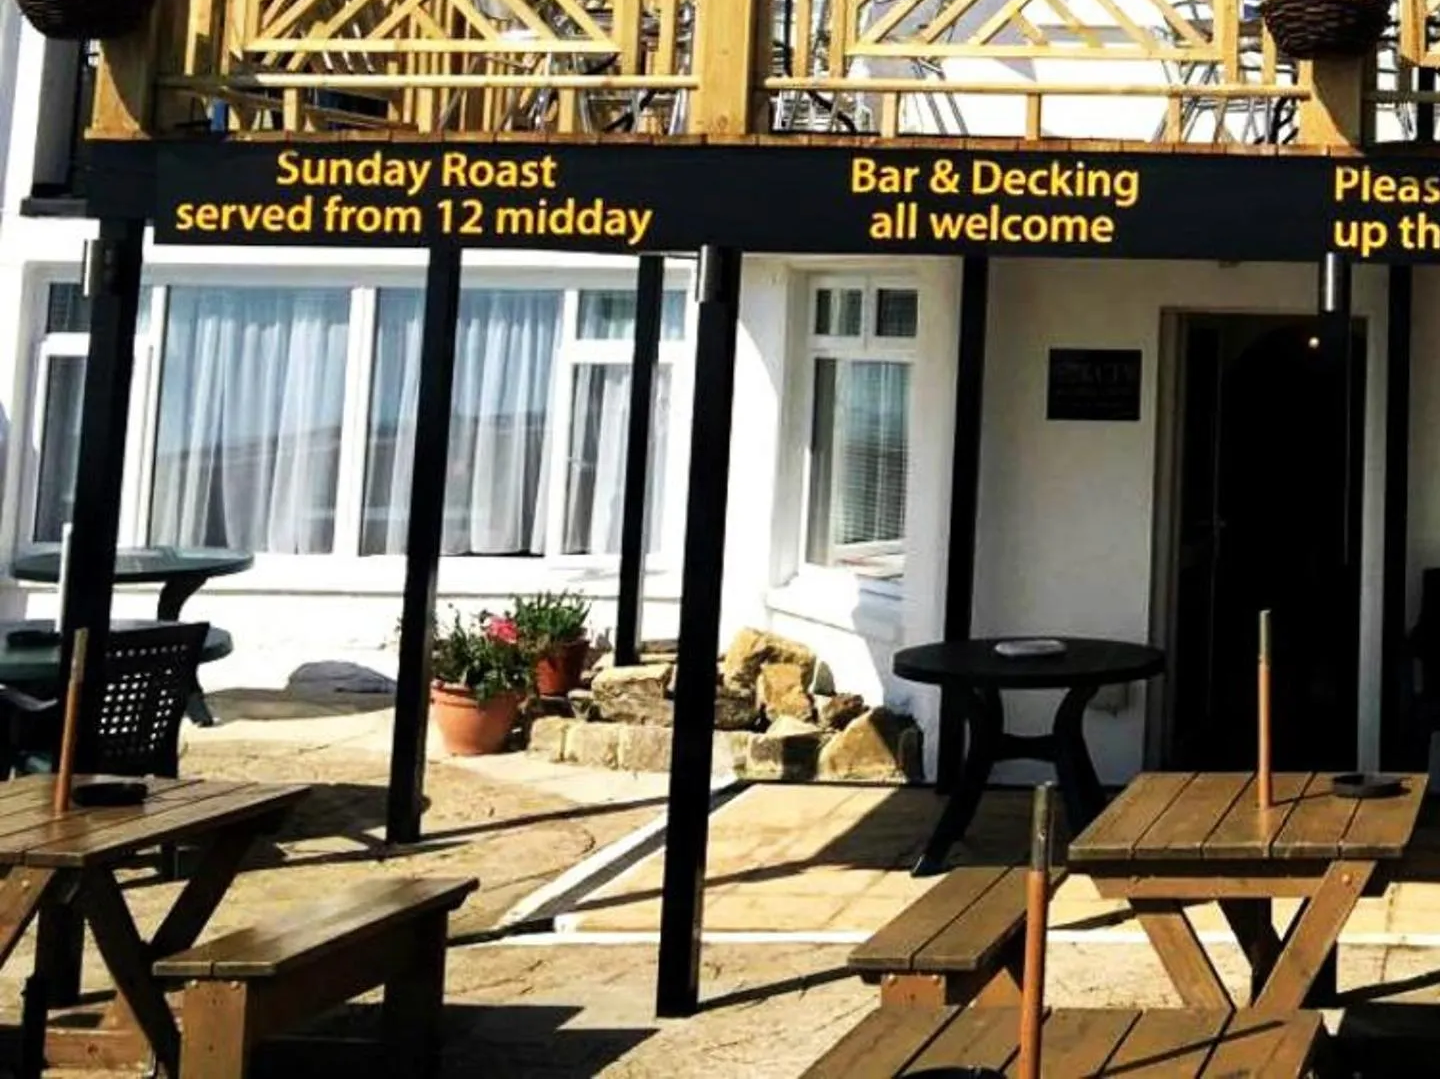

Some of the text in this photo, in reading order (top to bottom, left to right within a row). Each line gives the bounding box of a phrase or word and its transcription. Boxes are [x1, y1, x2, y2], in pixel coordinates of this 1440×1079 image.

[277, 151, 556, 195] Sunday Roast
[852, 158, 1138, 207] Bar & Decking
[176, 193, 652, 245] served from 12 midday
[870, 203, 1115, 242] all welcome
[1334, 221, 1387, 258] up
